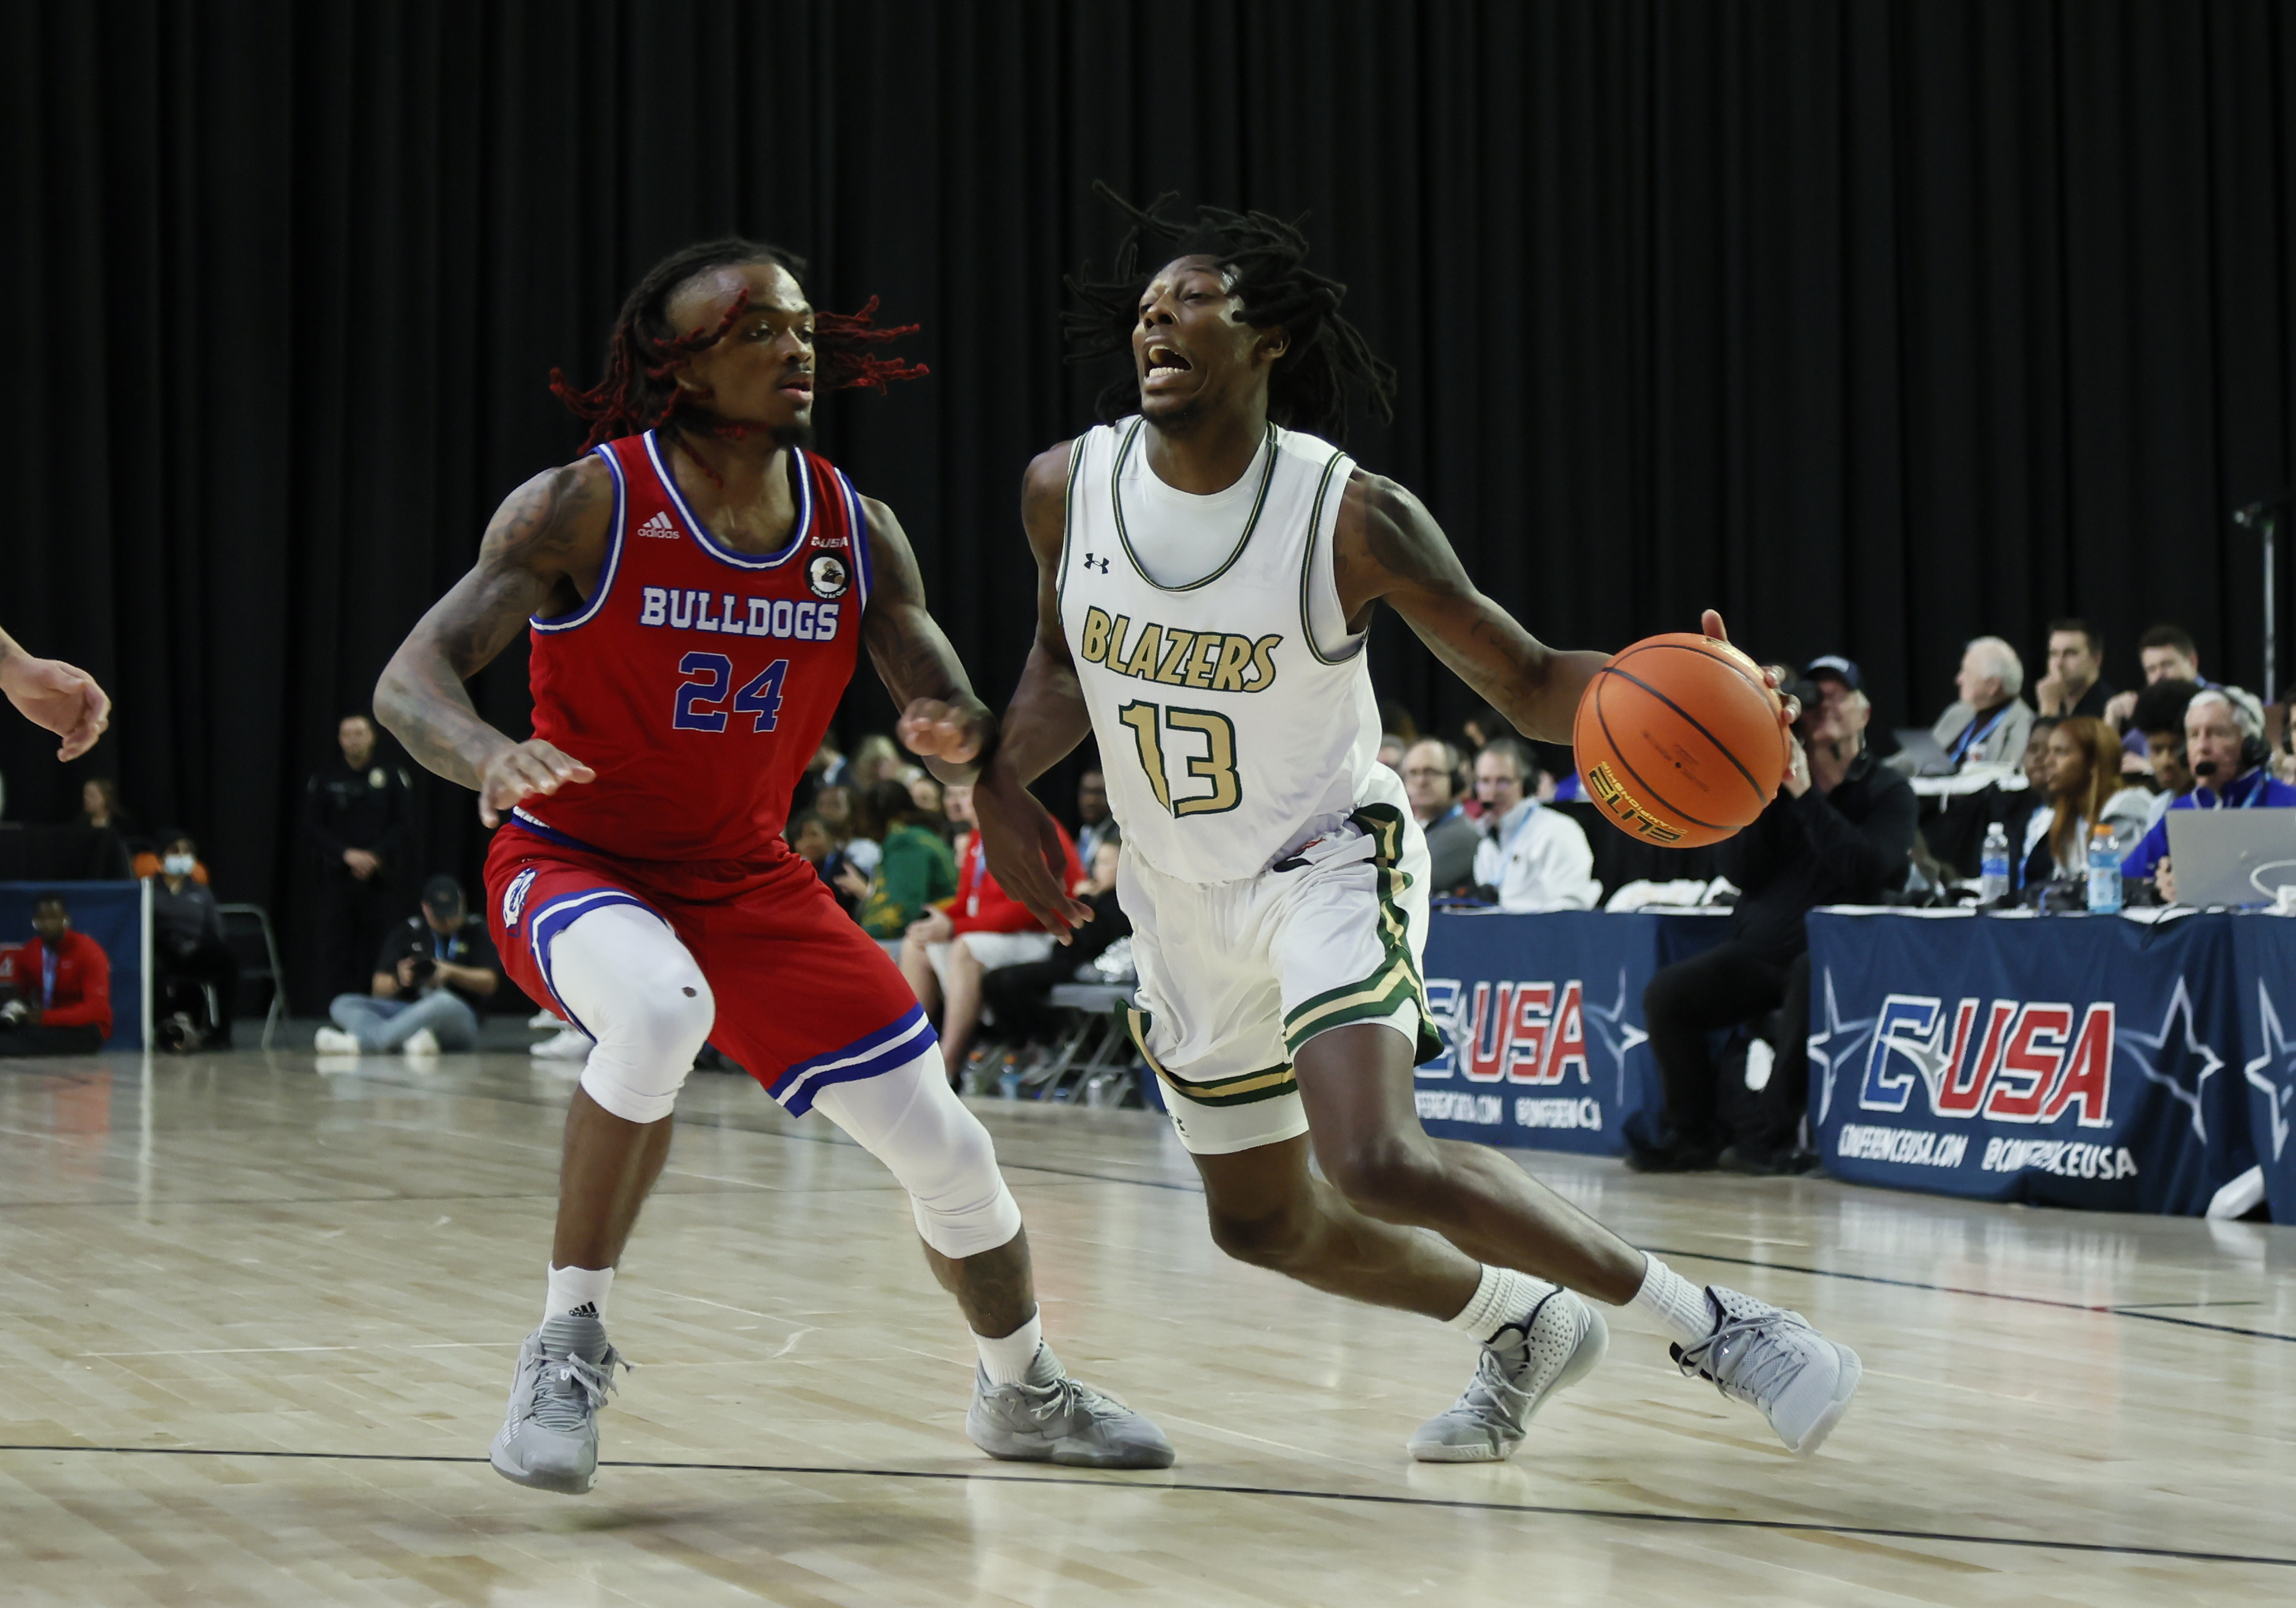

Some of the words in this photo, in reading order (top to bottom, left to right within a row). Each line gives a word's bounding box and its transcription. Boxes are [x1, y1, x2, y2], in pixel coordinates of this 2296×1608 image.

[637, 527, 680, 539] adidas
[640, 586, 840, 641] BULLDOGS
[1081, 605, 1284, 693] BLAZERS
[673, 651, 789, 733] 24
[1119, 699, 1242, 819] 13
[1589, 765, 1683, 843] ELITE
